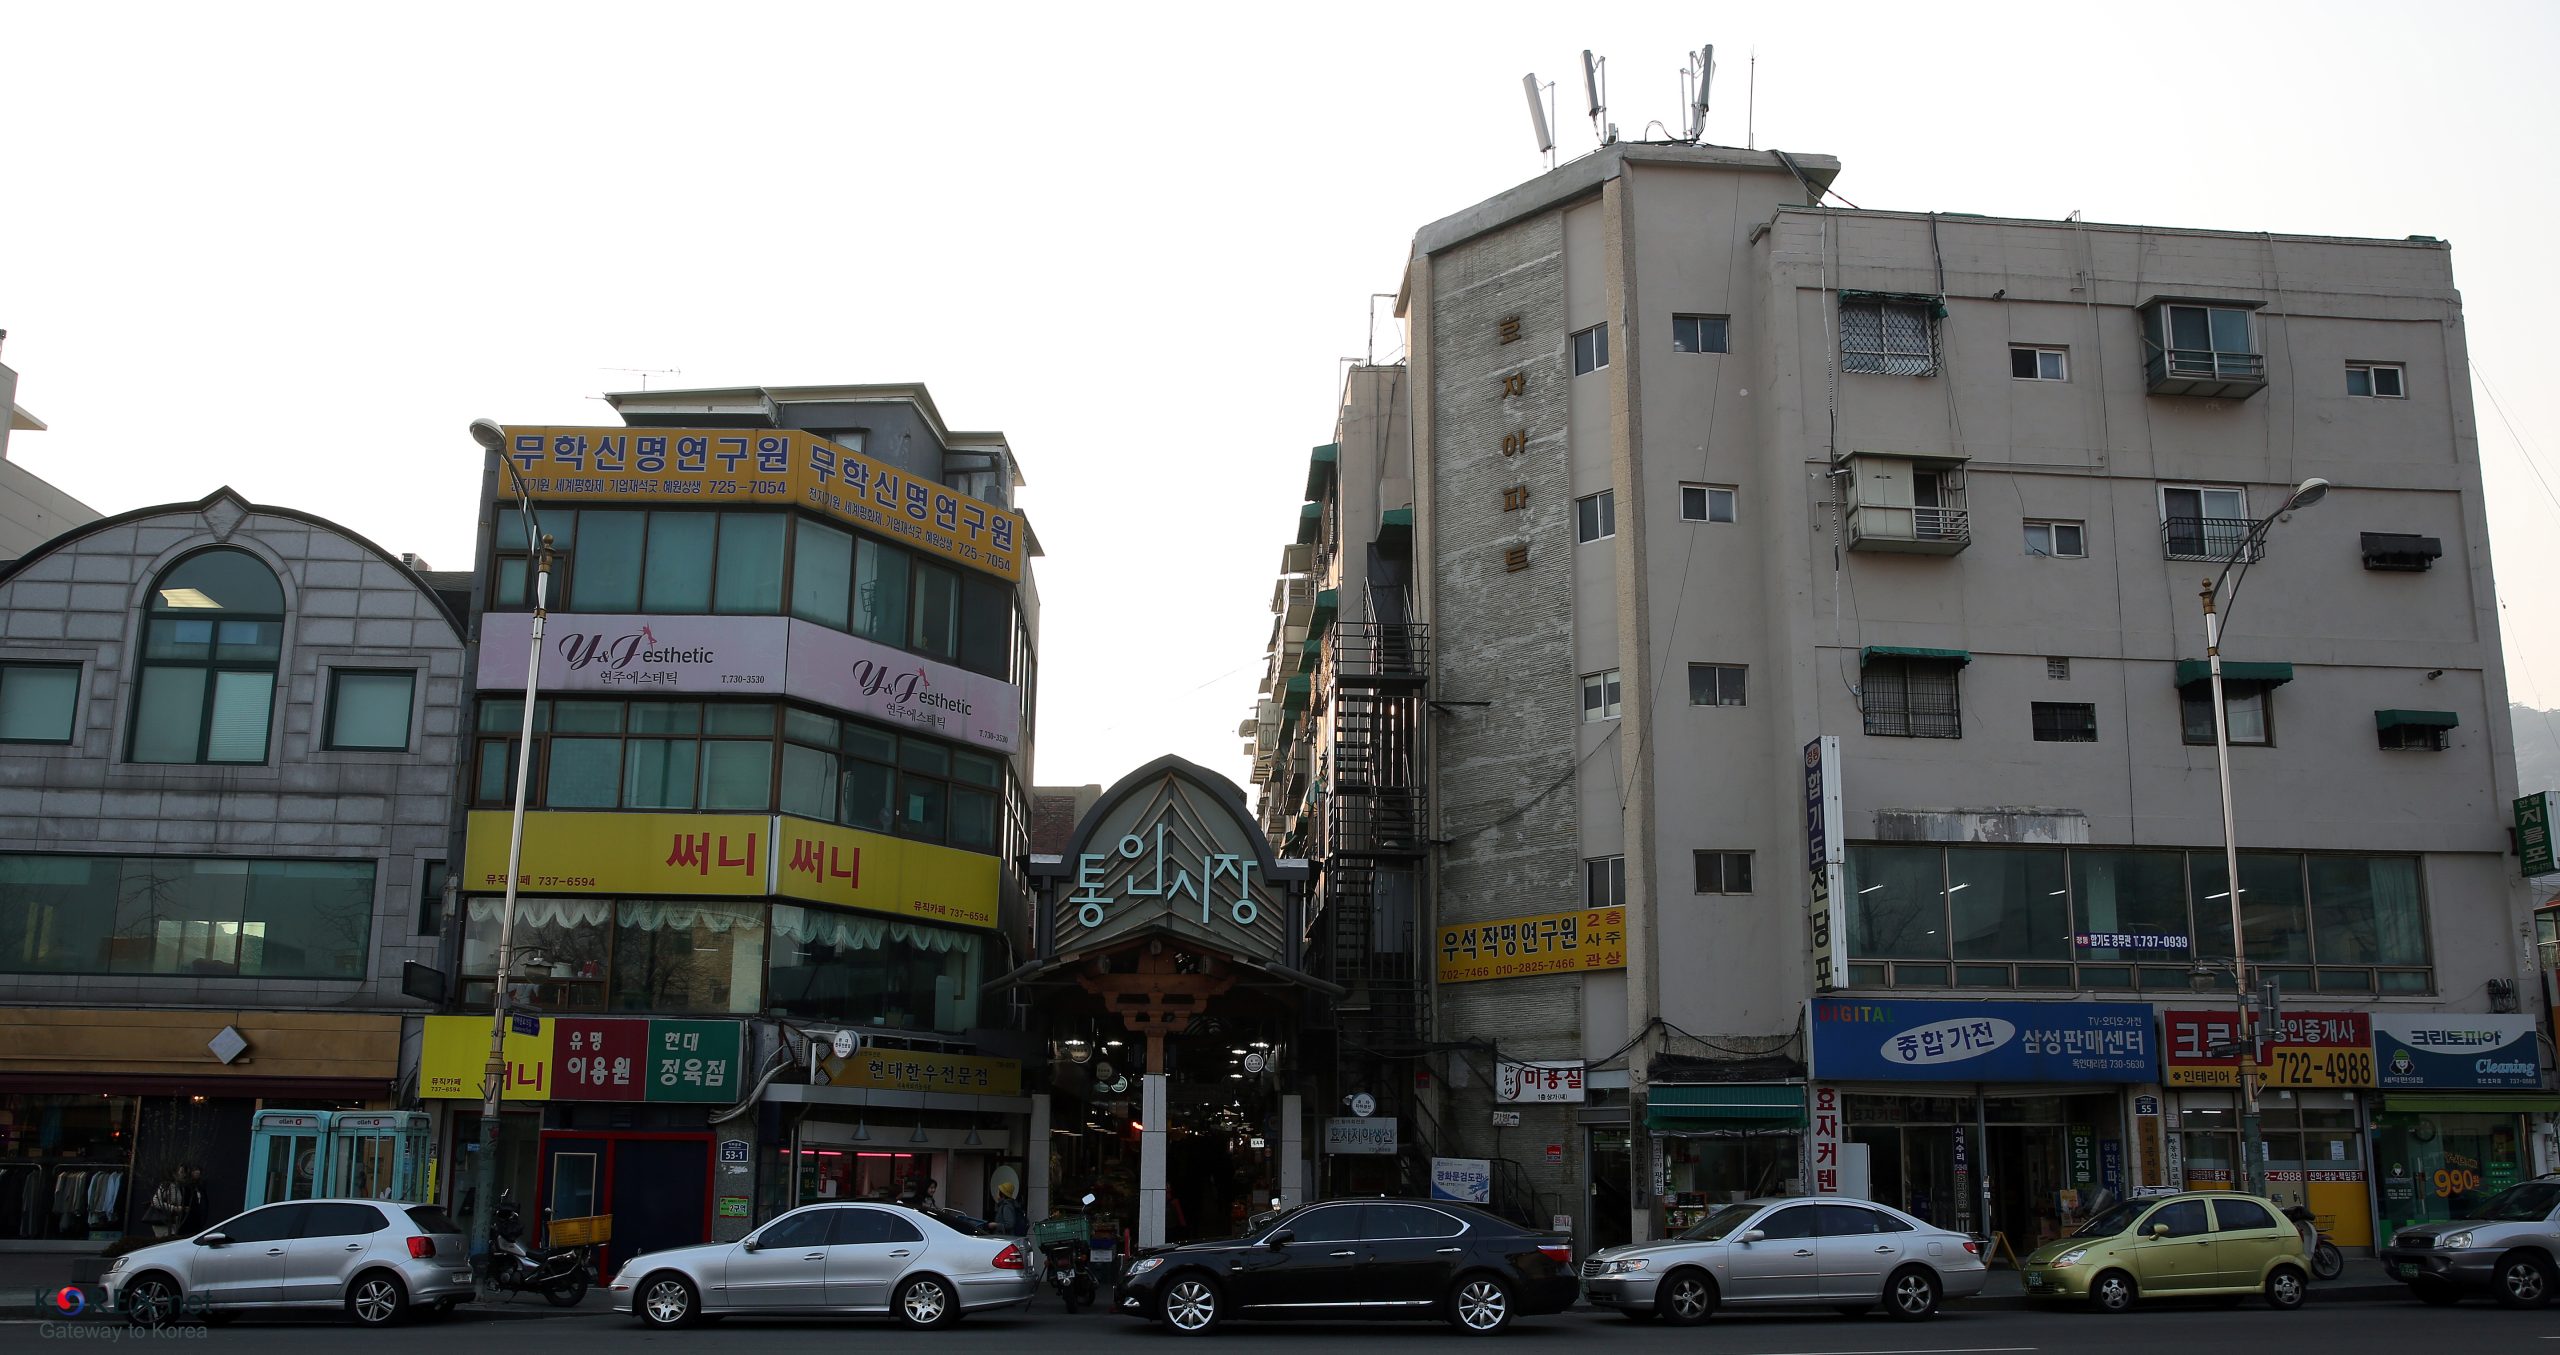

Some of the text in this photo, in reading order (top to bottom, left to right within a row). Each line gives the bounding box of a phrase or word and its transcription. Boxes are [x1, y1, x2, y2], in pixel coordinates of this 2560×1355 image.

[512, 435, 789, 473] 무학신명연구원
[709, 480, 787, 495] 725-7054
[809, 443, 1014, 552] 무학신명연구원
[957, 542, 1011, 572] 725-7054
[642, 646, 714, 664] esthetic
[600, 670, 679, 686] 연주에스테틱
[721, 674, 765, 684] T.730-3530
[919, 690, 972, 716] esthetic
[886, 702, 946, 730] 연주에스테틱
[1807, 771, 1824, 867] 합기도
[2520, 806, 2549, 864] 지물포
[666, 832, 756, 876] 써니
[789, 838, 861, 889] 써니
[485, 874, 595, 887] 뮤직페 737-6594
[1069, 823, 1258, 928] 통인시장
[913, 901, 989, 922] 뮤직카페 737-6594
[1811, 864, 1832, 994] 전당포
[2090, 934, 2111, 947] 합기도
[2132, 935, 2188, 948] T.737-0939
[1440, 958, 1575, 981] 702-7466 010-2825-7466
[1817, 1004, 1893, 1023] DIGITAL
[569, 1031, 603, 1052] 유명
[664, 1031, 700, 1052] 현대
[2021, 1028, 2144, 1056] 삼성판매센터
[2411, 1029, 2502, 1046] 크린토피아
[567, 1056, 631, 1086] 이용원
[660, 1058, 727, 1087] 정육점
[2071, 1058, 2144, 1070] 옥인대리점 730-5630
[2277, 1052, 2371, 1085] 722-4988
[2475, 1058, 2535, 1077] Cleaning
[431, 1077, 462, 1086] 뮤직카페
[1525, 1066, 1582, 1090] 미용실
[2183, 1069, 2230, 1084] 인테리어
[2141, 1105, 2152, 1113] 55
[1815, 1087, 1838, 1193] 효자커텐
[1954, 1127, 1966, 1161] 시계수리
[725, 1150, 743, 1160] 53-1
[2074, 1136, 2091, 1183] 안일지물
